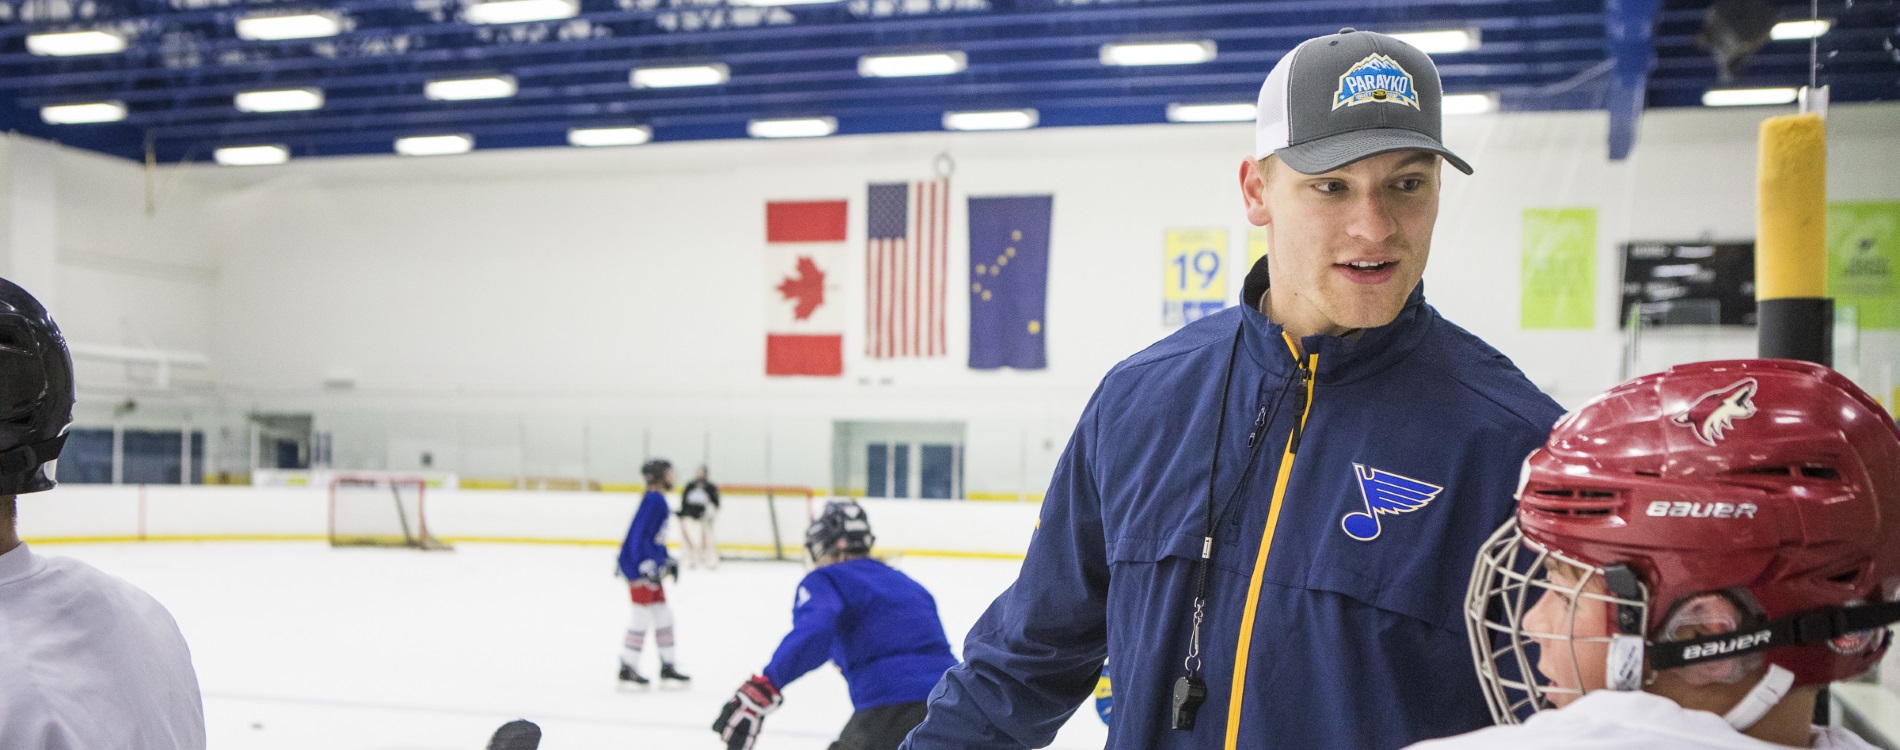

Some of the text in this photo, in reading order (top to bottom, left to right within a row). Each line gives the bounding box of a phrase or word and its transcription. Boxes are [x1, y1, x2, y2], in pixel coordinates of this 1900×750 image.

[1345, 74, 1408, 94] PARAYKO
[1172, 249, 1220, 290] 19
[1646, 500, 1758, 519] BAUER
[1683, 629, 1772, 660] BAUER
